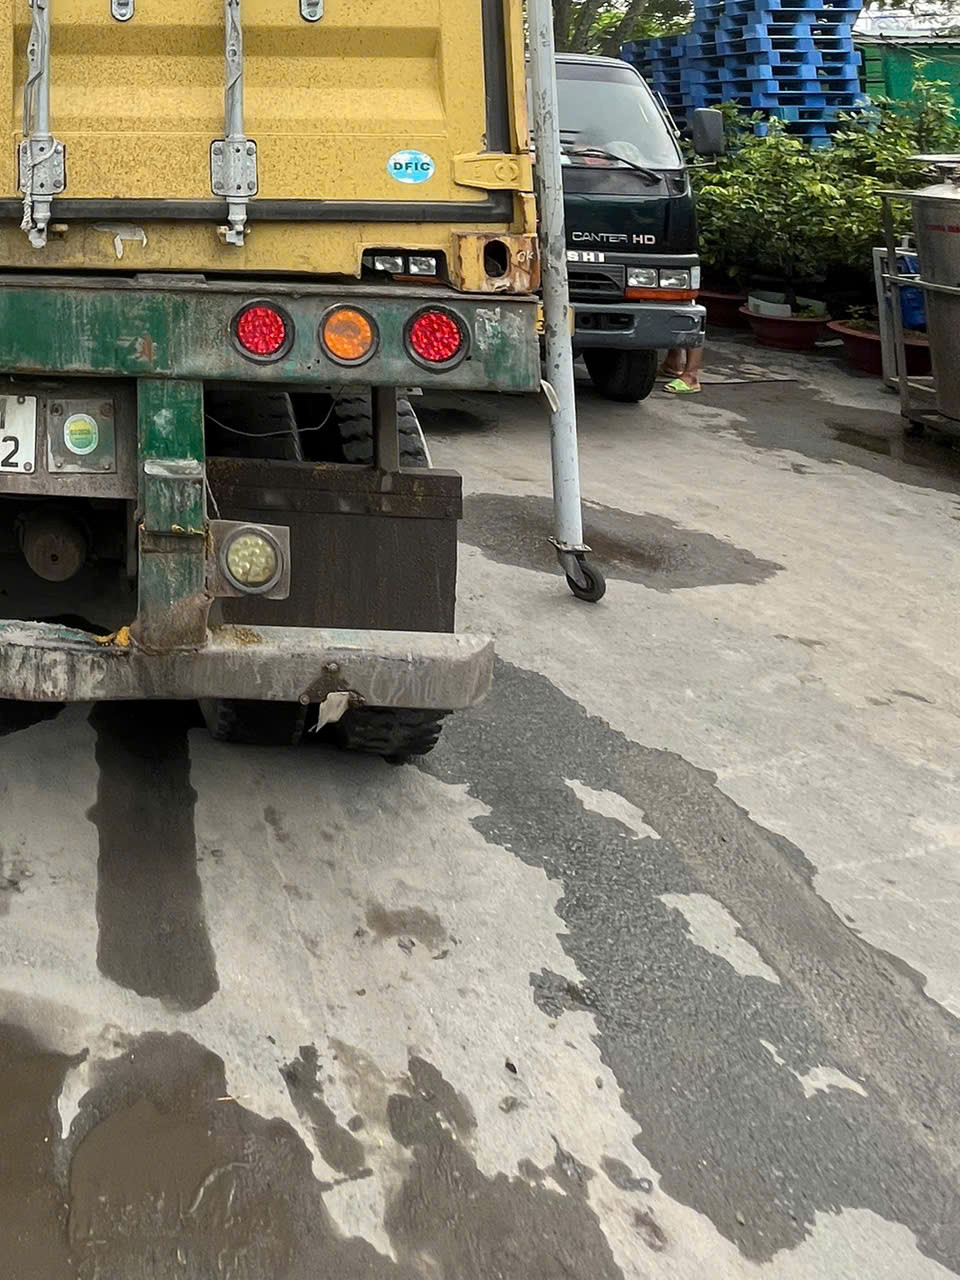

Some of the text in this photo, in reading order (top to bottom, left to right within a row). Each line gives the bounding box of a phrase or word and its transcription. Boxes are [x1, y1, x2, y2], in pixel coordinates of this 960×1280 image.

[393, 162, 431, 171] DFIC
[572, 231, 656, 245] CANTER HD
